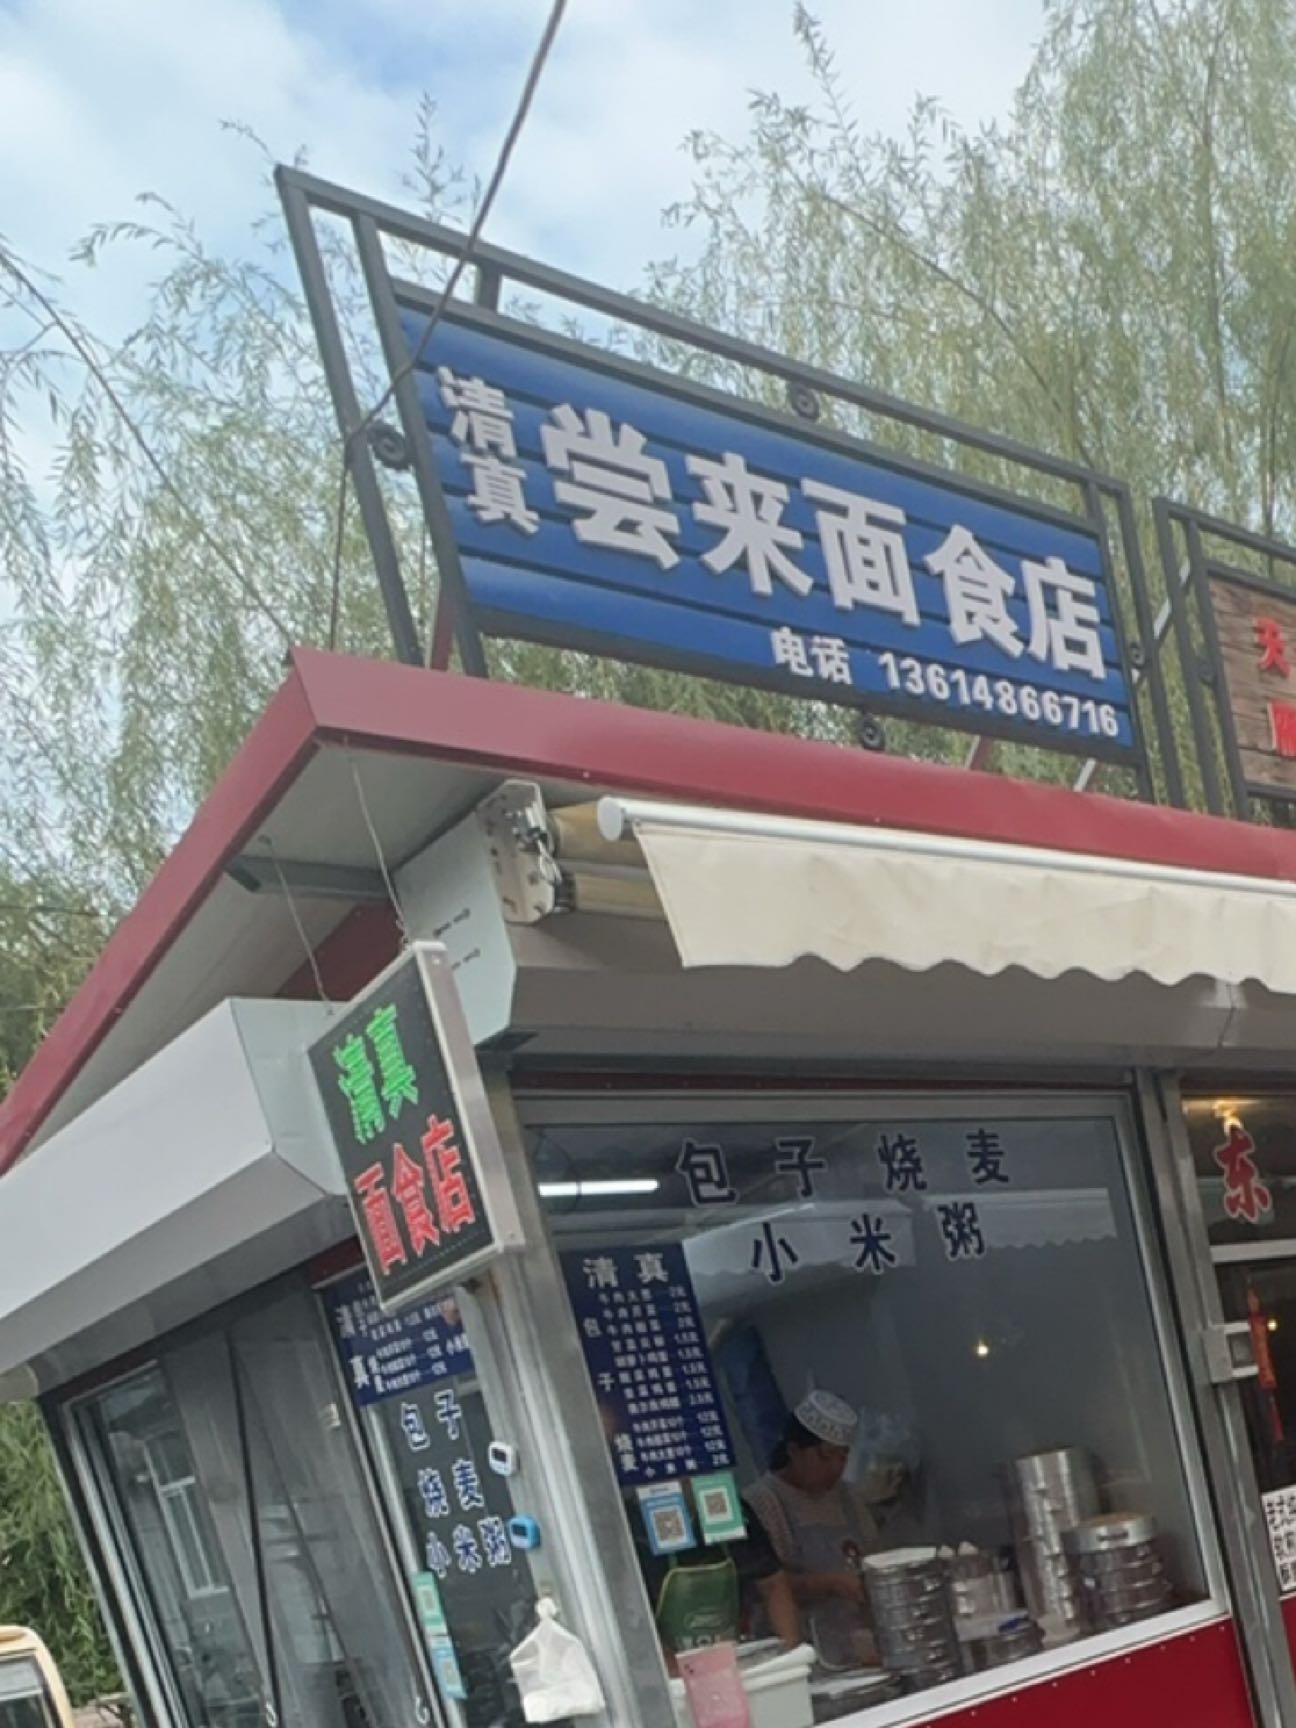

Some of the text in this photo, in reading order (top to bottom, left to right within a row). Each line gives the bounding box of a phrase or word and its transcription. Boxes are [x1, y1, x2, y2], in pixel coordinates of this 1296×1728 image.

[437, 366, 540, 536] 清真
[538, 403, 1110, 681] 尝来面食店
[769, 626, 1120, 739] 电话 13614866716
[332, 1003, 419, 1145] 清真
[354, 1113, 477, 1276] 面食店
[677, 1129, 1010, 1207] 包子烧麦
[582, 1252, 669, 1289] 清真
[750, 1201, 986, 1286] 小米粥
[400, 1388, 462, 1452] 包子
[417, 1458, 485, 1519] 烧麦
[426, 1516, 513, 1579] 小米粥
